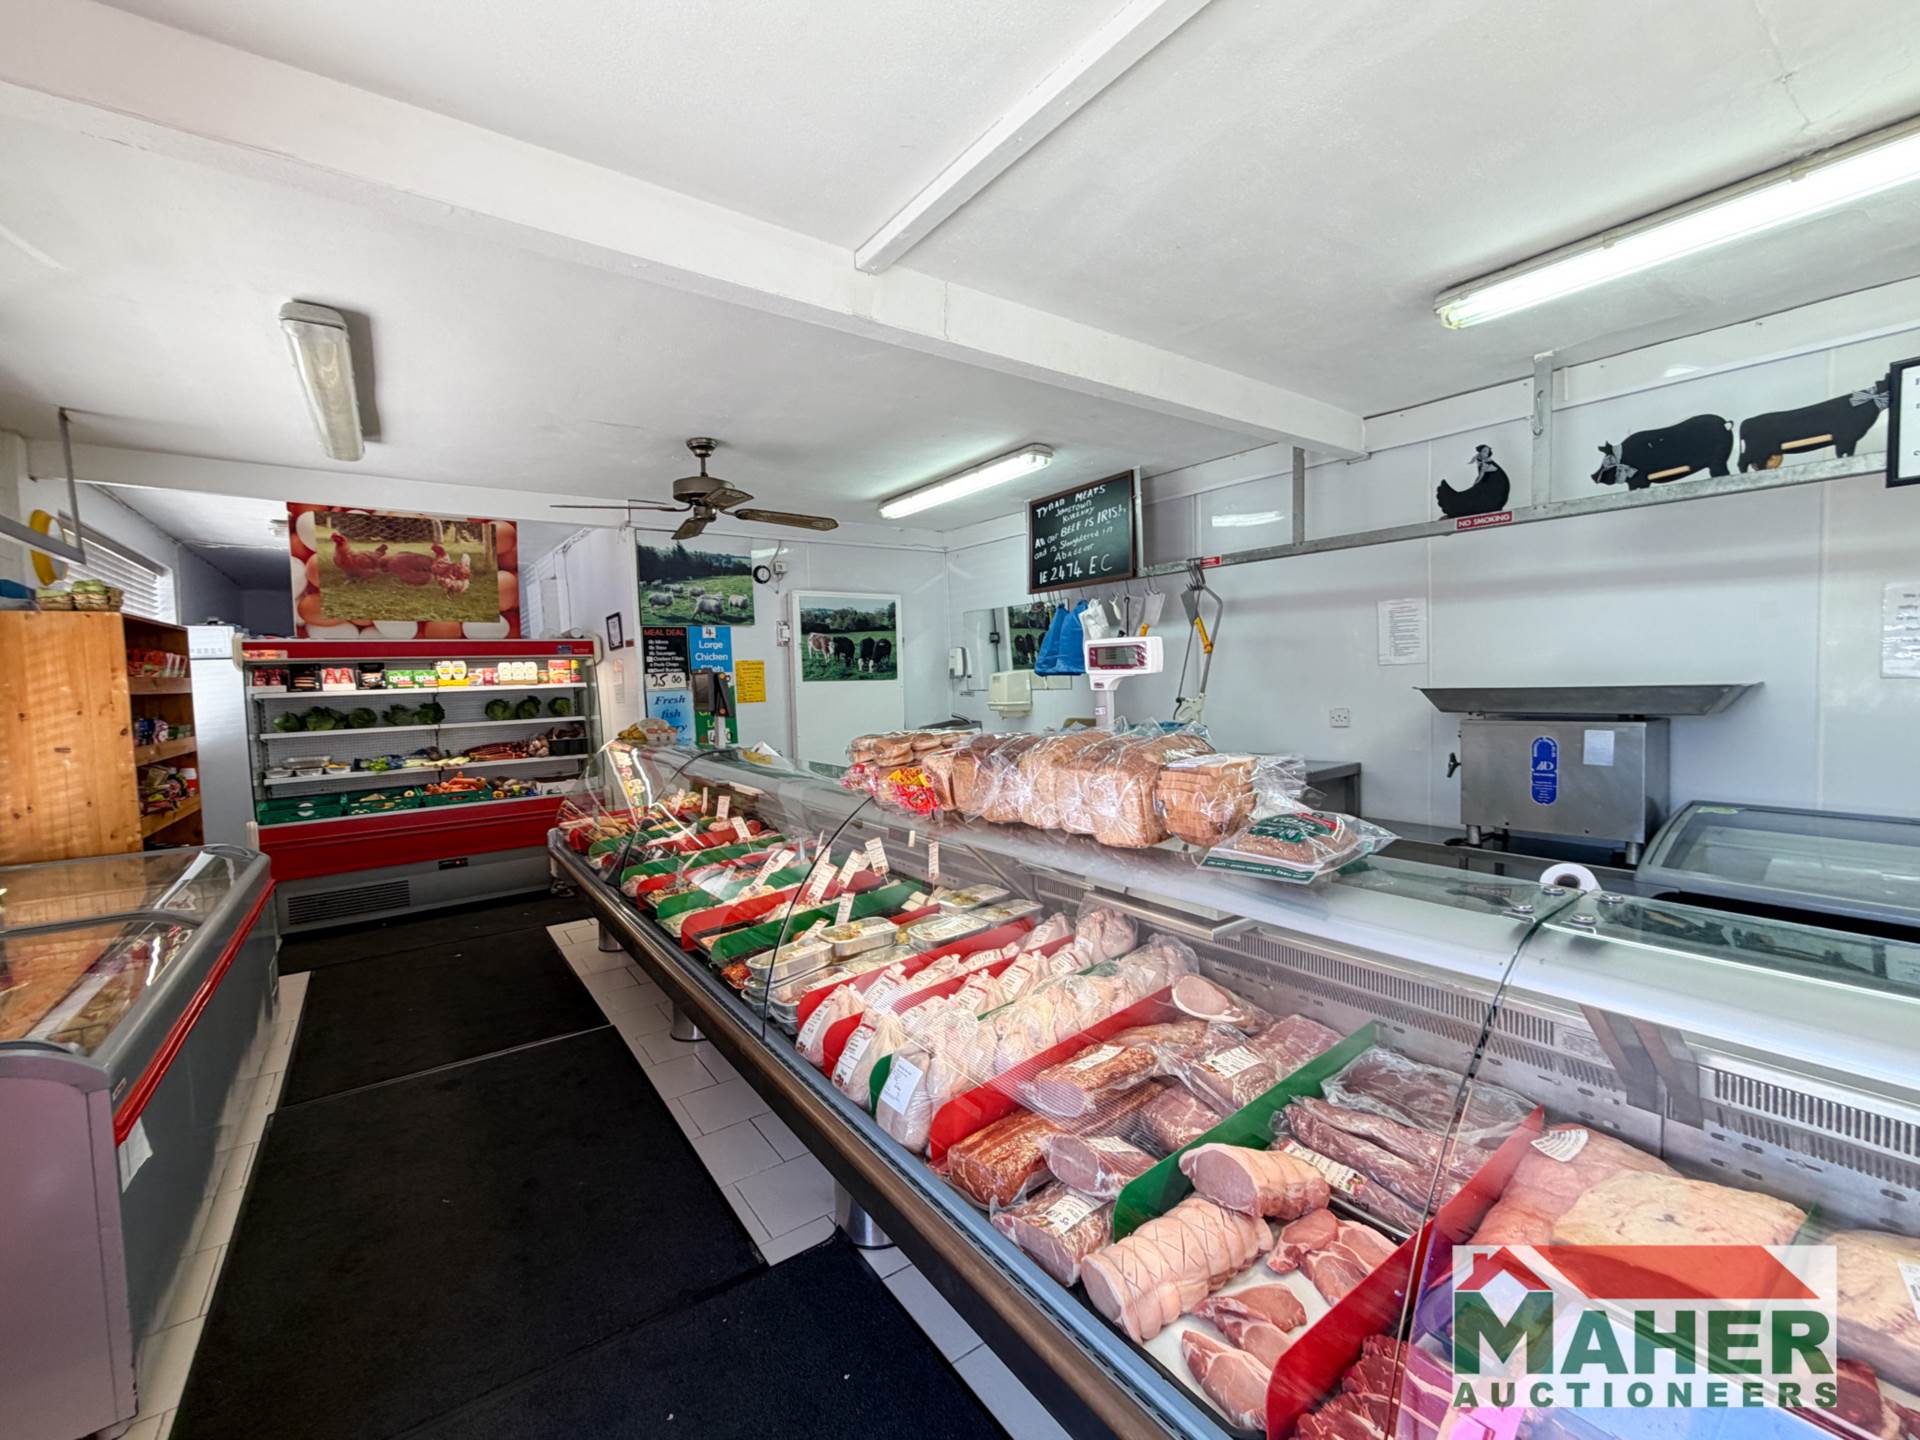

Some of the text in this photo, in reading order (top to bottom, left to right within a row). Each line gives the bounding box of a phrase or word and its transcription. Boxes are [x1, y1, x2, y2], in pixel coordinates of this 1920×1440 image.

[1075, 485, 1106, 502] MEATS
[1474, 513, 1510, 524] SMOKING
[1060, 521, 1080, 537] BEEF
[1050, 560, 1083, 581] 2474
[699, 641, 724, 649] Large
[695, 653, 729, 661] Chicken
[655, 695, 686, 705] Fresh
[661, 708, 681, 720] fish
